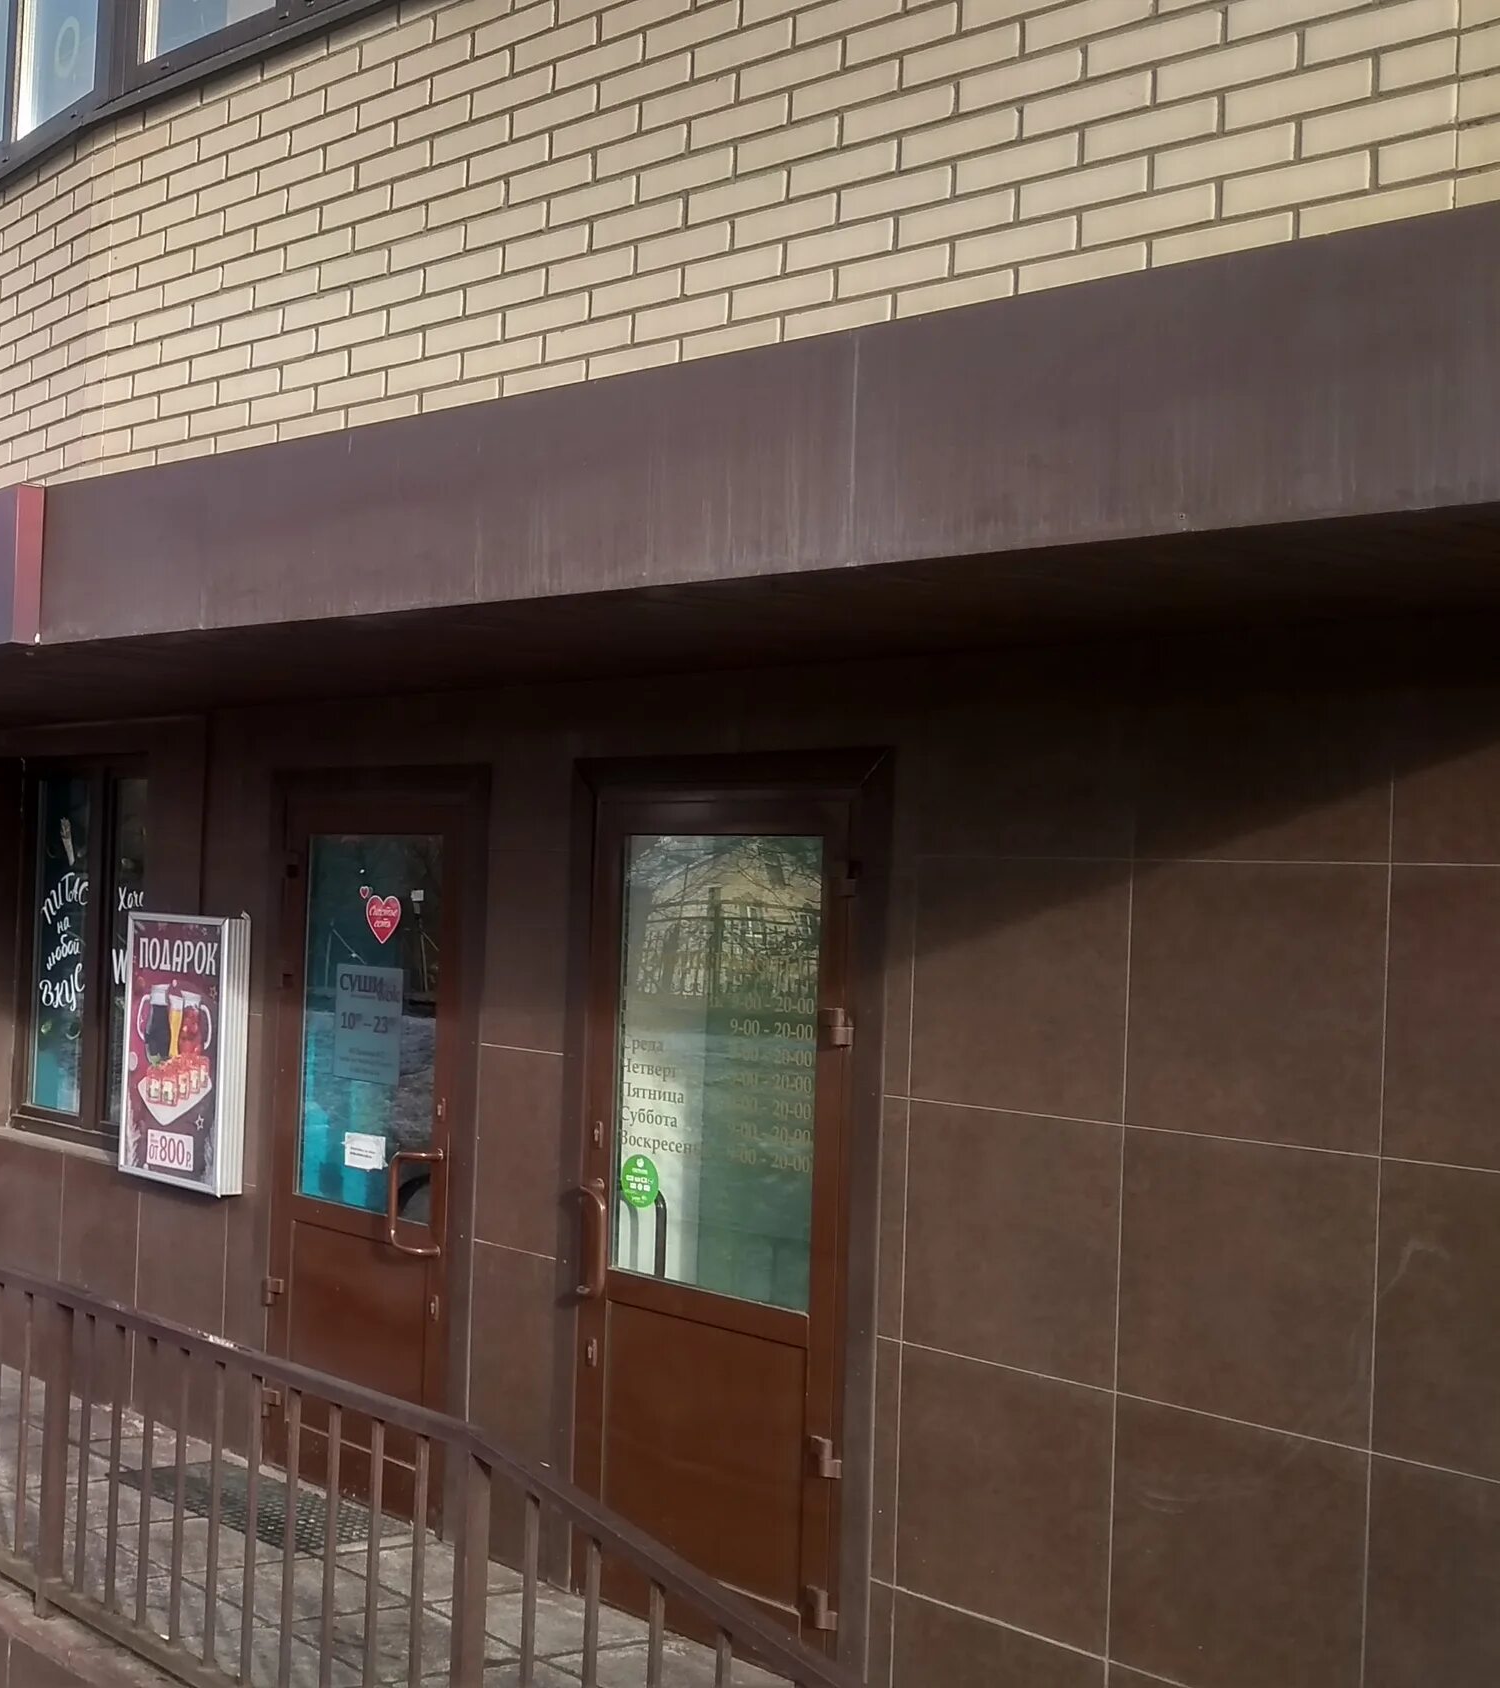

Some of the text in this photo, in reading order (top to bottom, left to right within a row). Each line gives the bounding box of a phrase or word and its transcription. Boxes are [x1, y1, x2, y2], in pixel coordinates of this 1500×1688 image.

[57, 916, 71, 934] на
[46, 934, 81, 971] любой
[139, 937, 218, 976] ПОДАРОК
[340, 973, 384, 993] СУШИ
[730, 1018, 761, 1036] 9-00
[774, 1021, 814, 1041] 20-00
[621, 1105, 677, 1128] Суббота
[159, 1135, 185, 1166] 800
